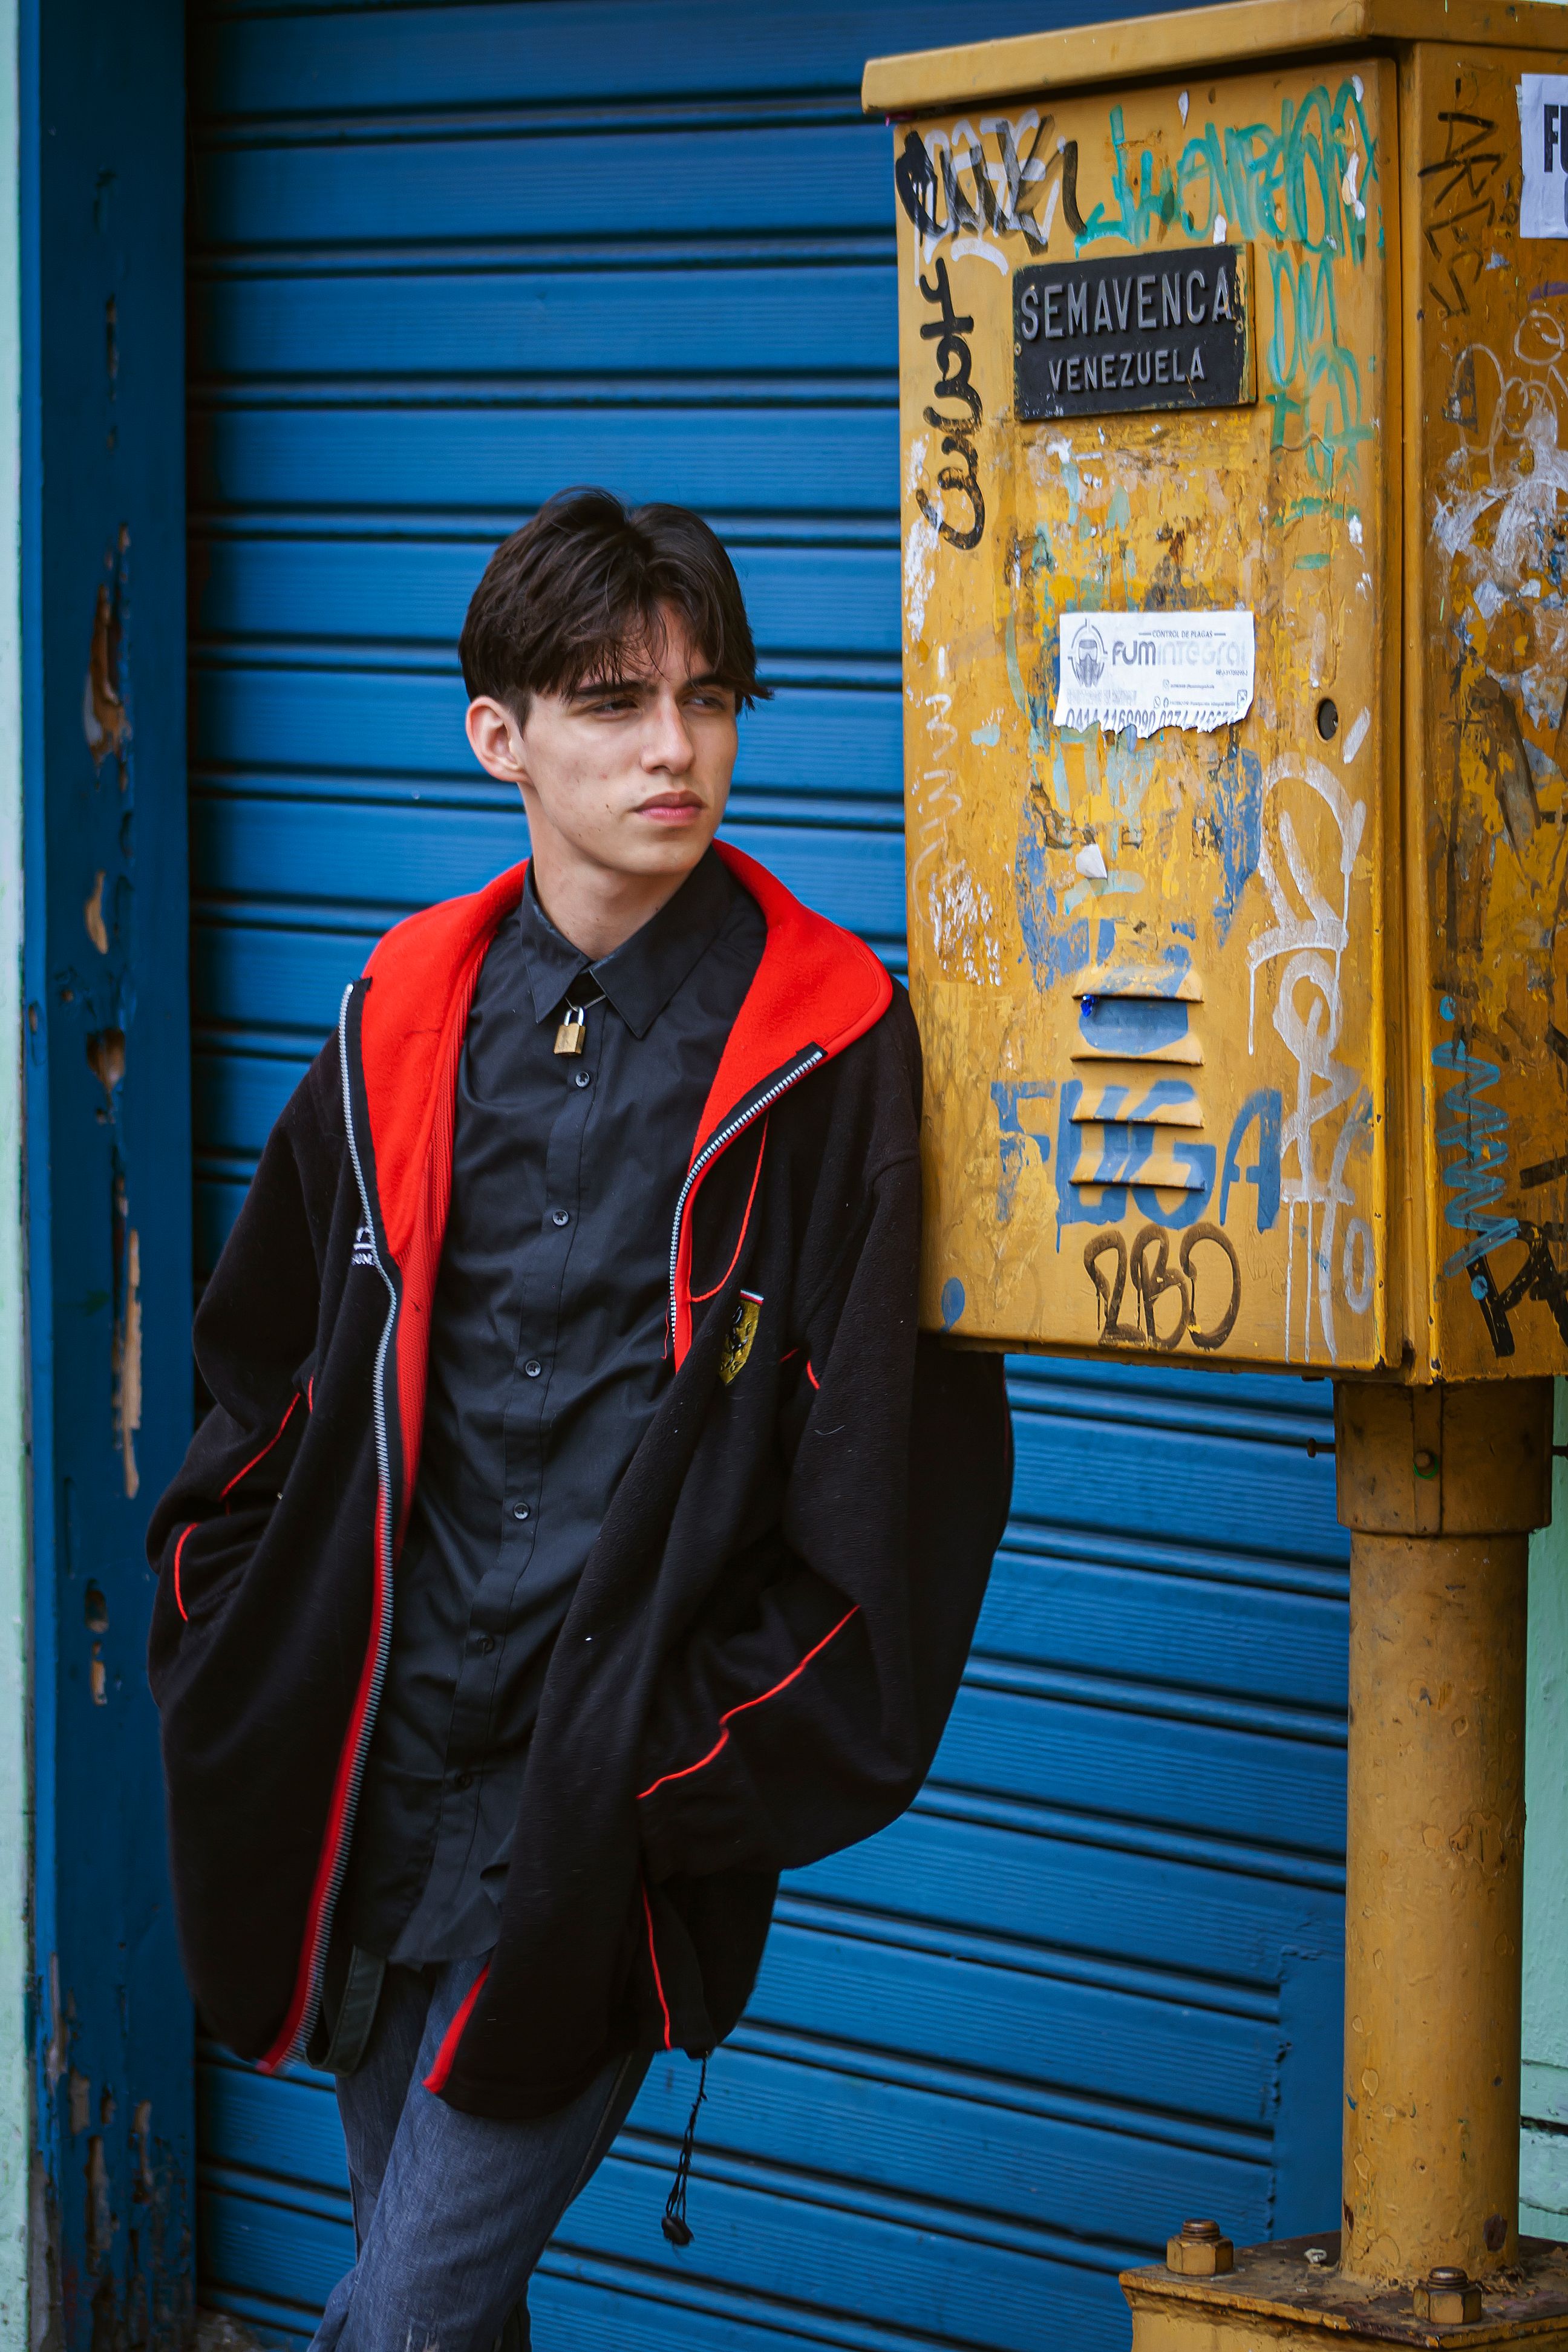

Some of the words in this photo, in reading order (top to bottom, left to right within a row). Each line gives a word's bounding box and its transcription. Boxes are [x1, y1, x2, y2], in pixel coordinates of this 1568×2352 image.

[1544, 104, 1568, 174] F
[1020, 267, 1235, 342] SEMAVENCA
[1048, 347, 1207, 394] VENEZUELA
[1152, 630, 1179, 638] CONTROL
[1181, 630, 1189, 638] DE
[1191, 630, 1214, 638] PLAGAS
